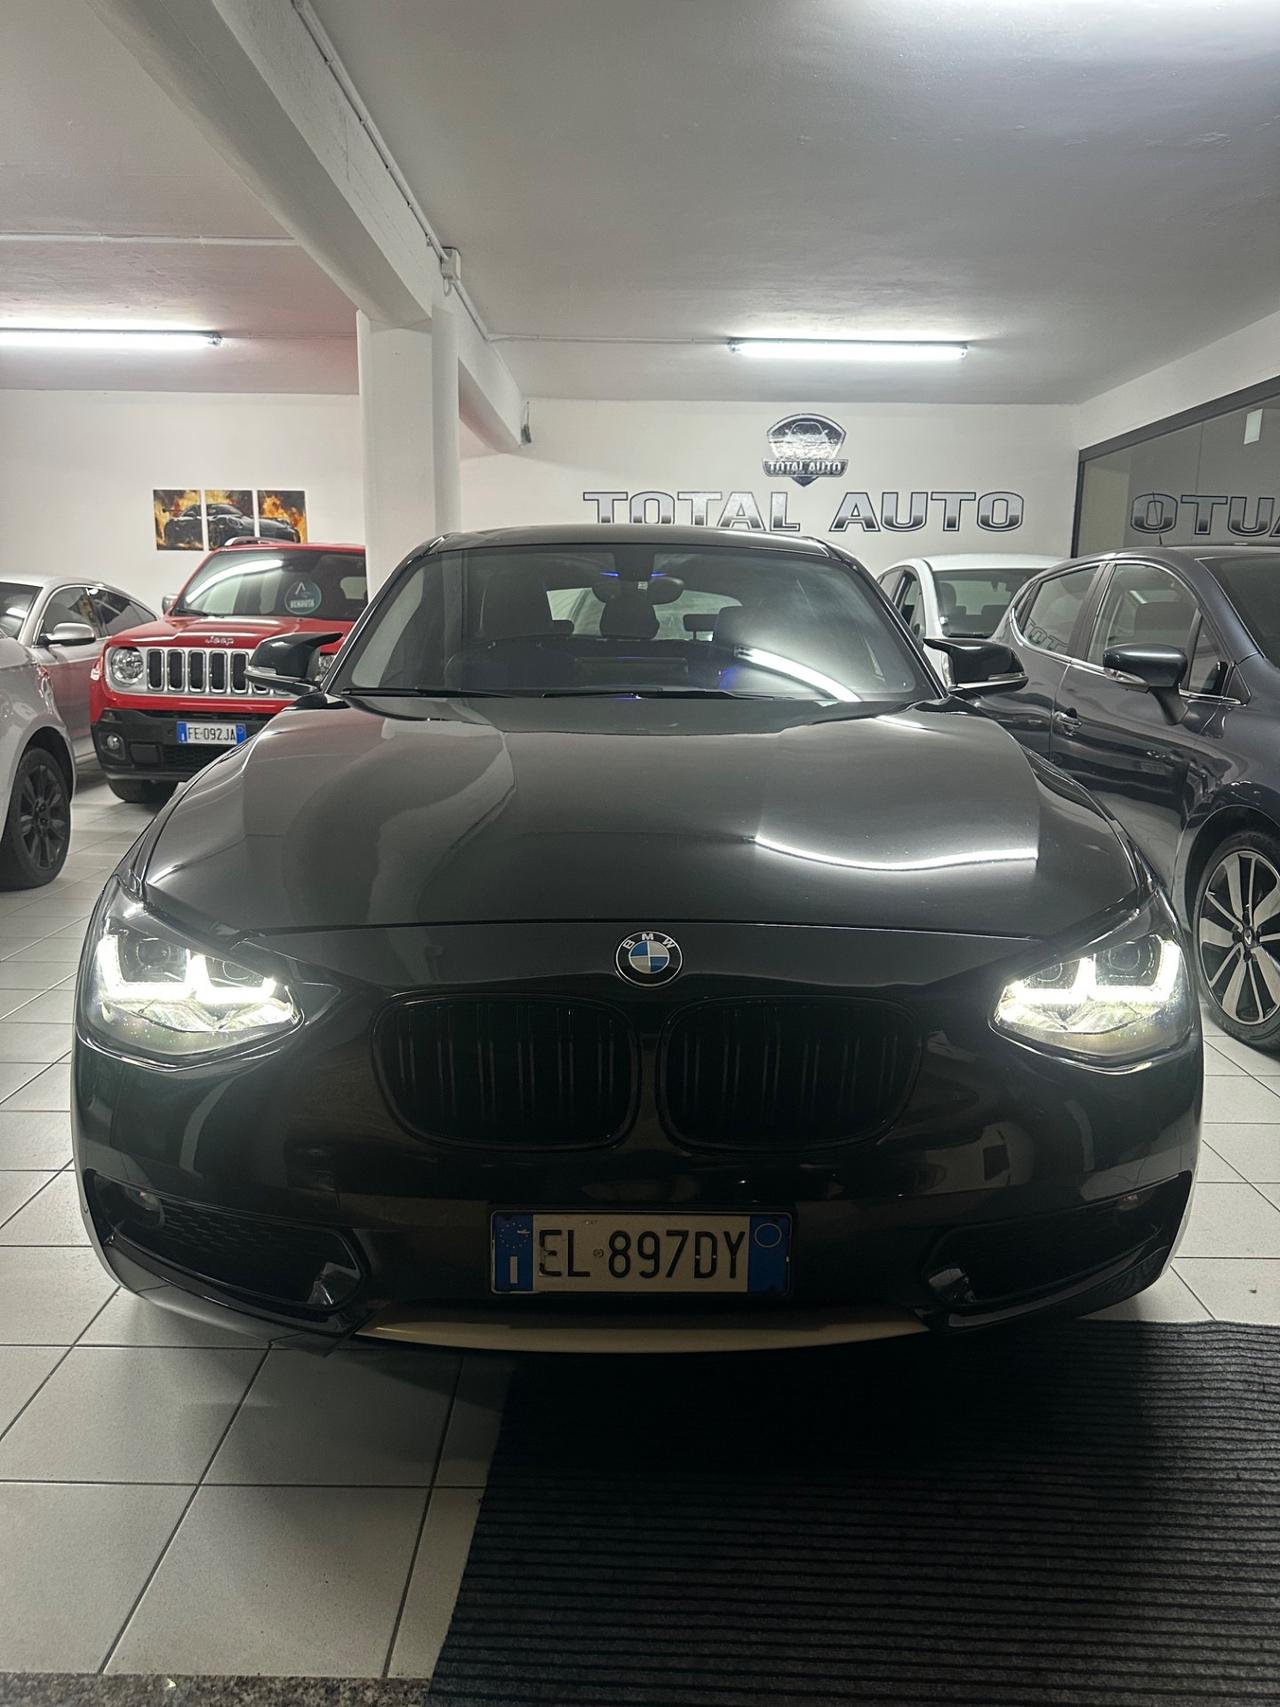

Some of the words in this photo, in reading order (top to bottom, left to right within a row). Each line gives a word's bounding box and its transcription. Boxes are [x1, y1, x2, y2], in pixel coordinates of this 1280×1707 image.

[768, 461, 806, 474] TOTAL
[808, 461, 842, 474] AUTO
[583, 491, 801, 532] TOTAL
[828, 491, 1025, 533] AUTO
[205, 635, 234, 646] Jeep
[622, 933, 676, 950] BMW
